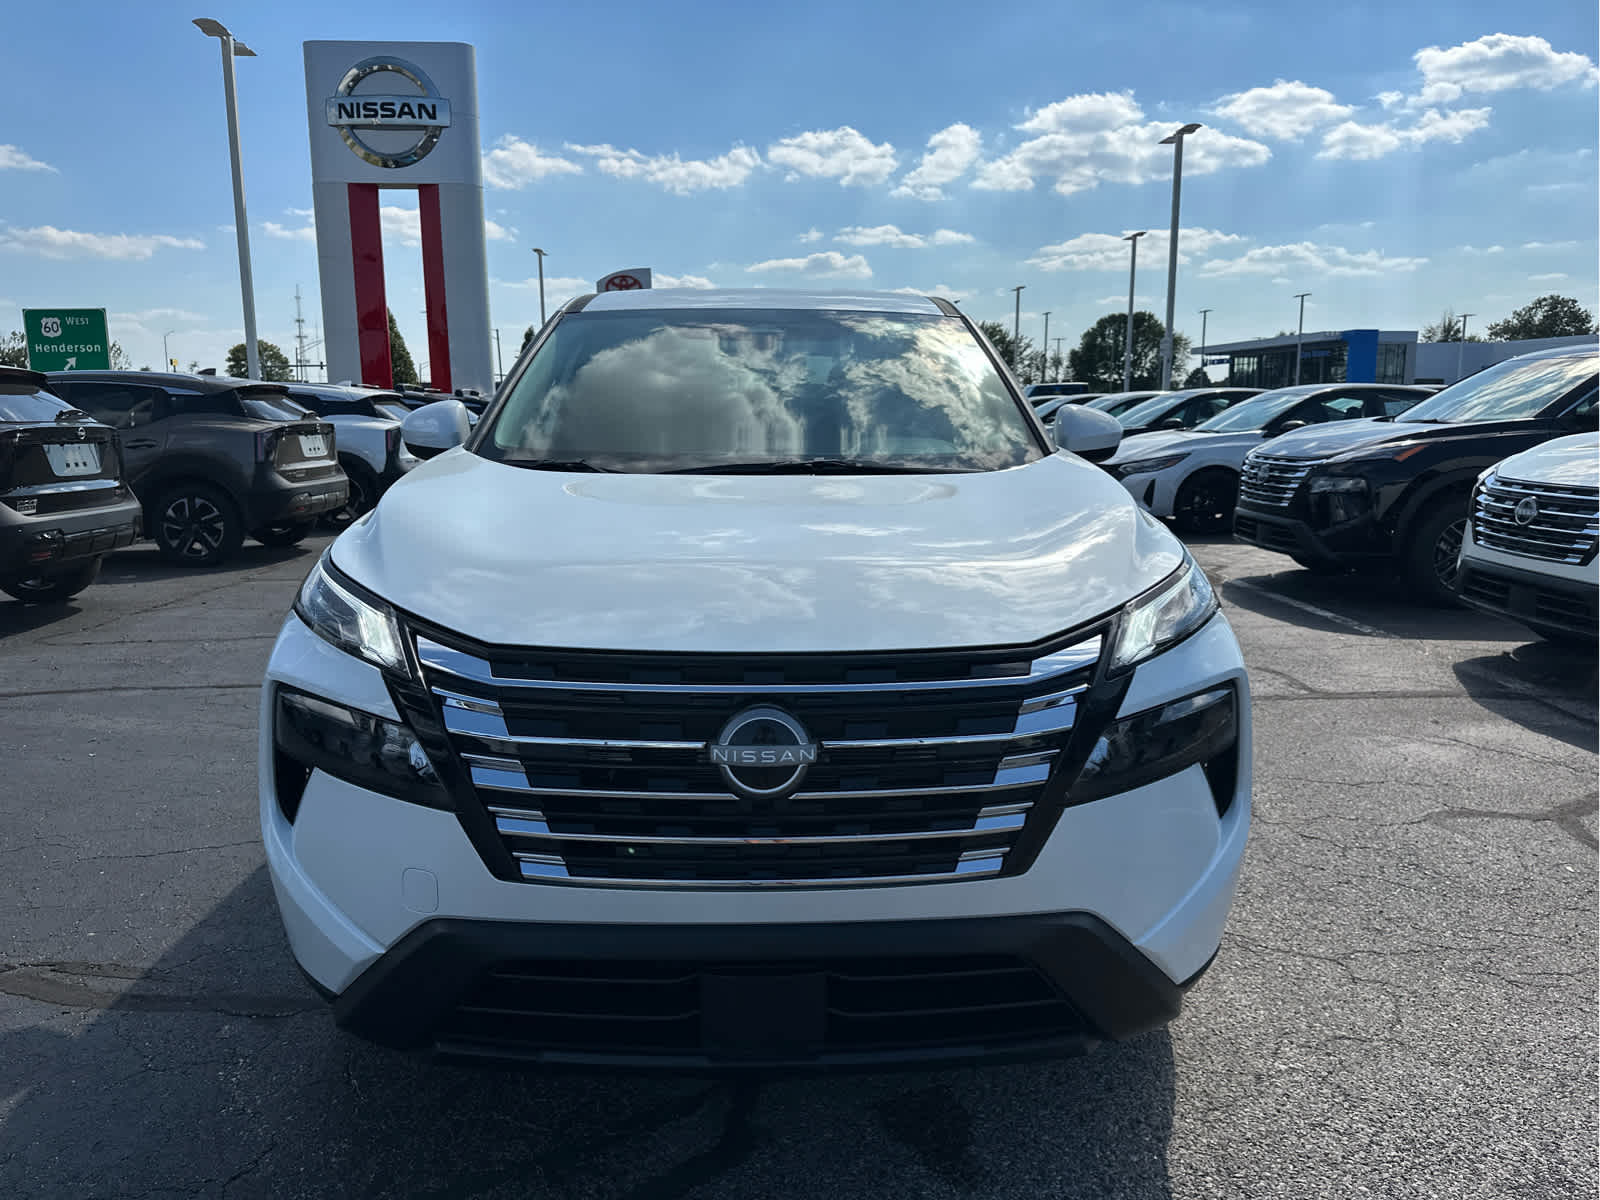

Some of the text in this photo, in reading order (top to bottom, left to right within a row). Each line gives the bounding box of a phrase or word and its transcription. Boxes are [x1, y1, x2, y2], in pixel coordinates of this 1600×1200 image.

[338, 102, 437, 120] NISSAN
[43, 316, 89, 334] 60 WEST
[35, 343, 101, 353] Henderson
[712, 748, 815, 763] NISSAN
